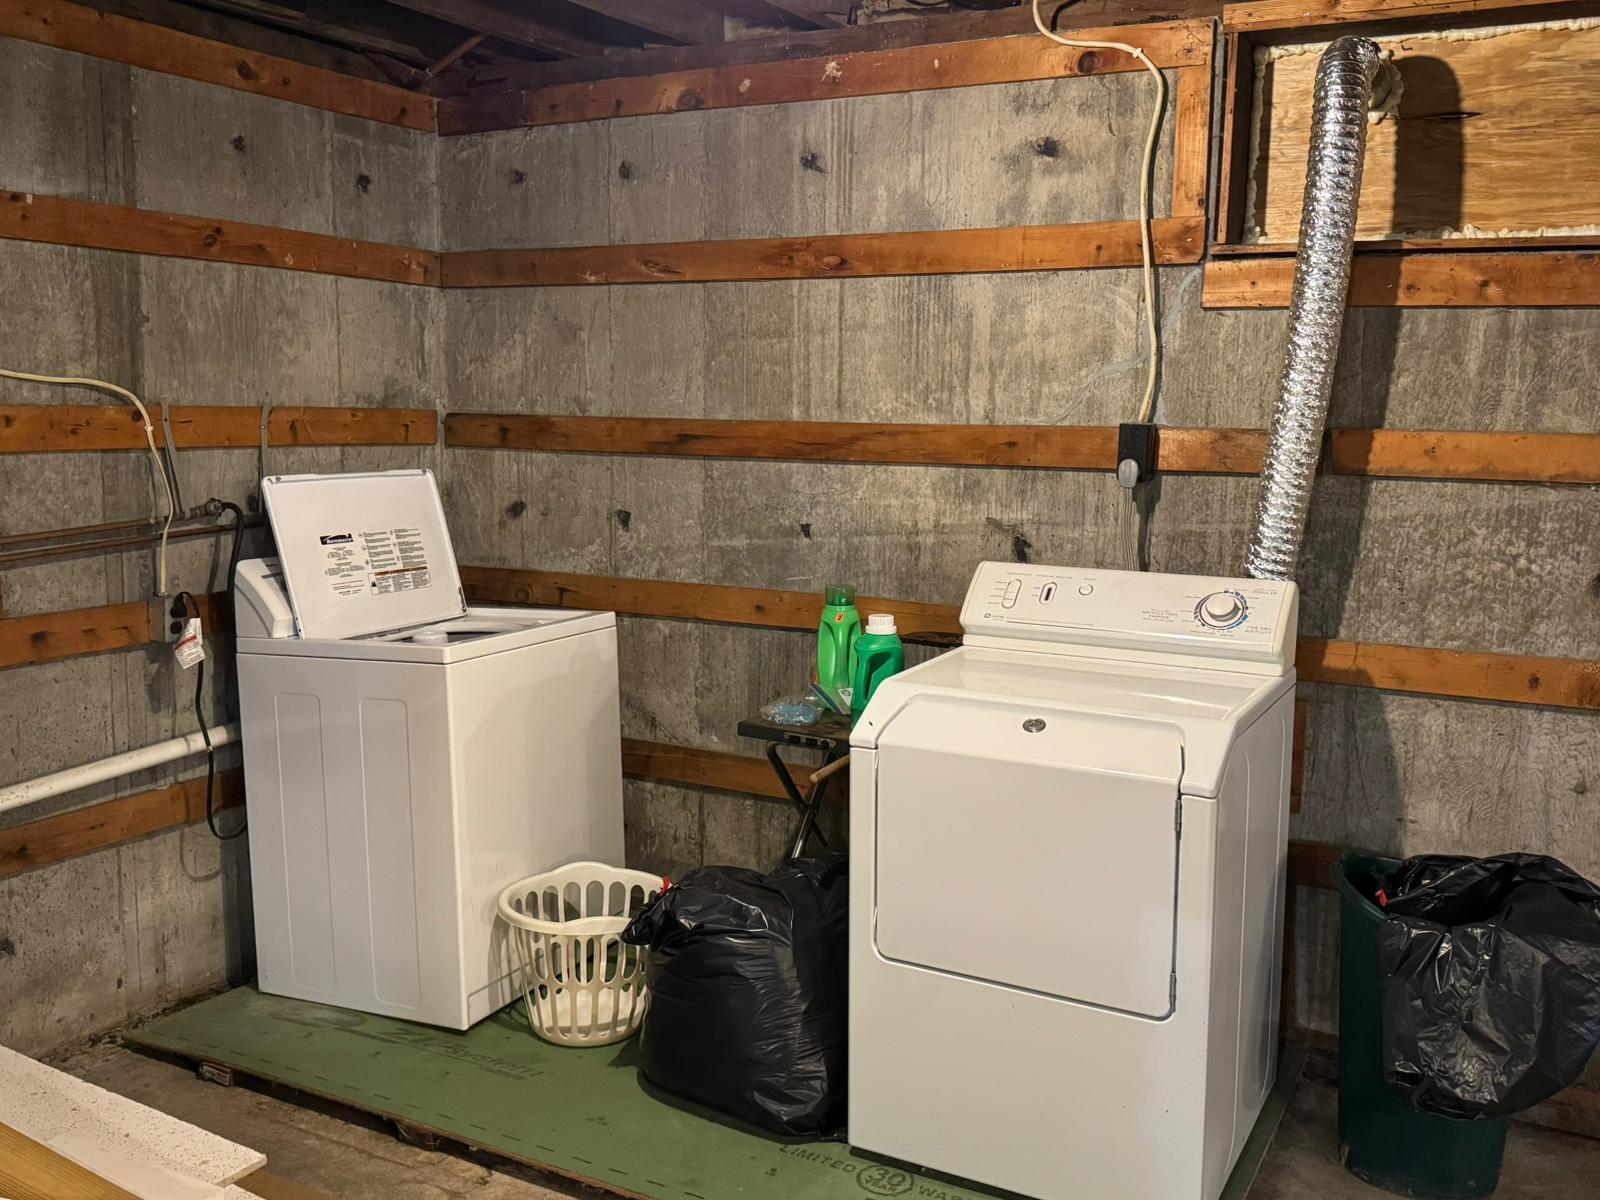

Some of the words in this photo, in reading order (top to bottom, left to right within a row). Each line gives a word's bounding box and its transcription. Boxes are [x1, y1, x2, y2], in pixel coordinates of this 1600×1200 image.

[779, 1144, 856, 1173] LIMITED
[872, 1166, 907, 1187] 30
[919, 1185, 972, 1200] WAR
[864, 1173, 898, 1193] YEAR
